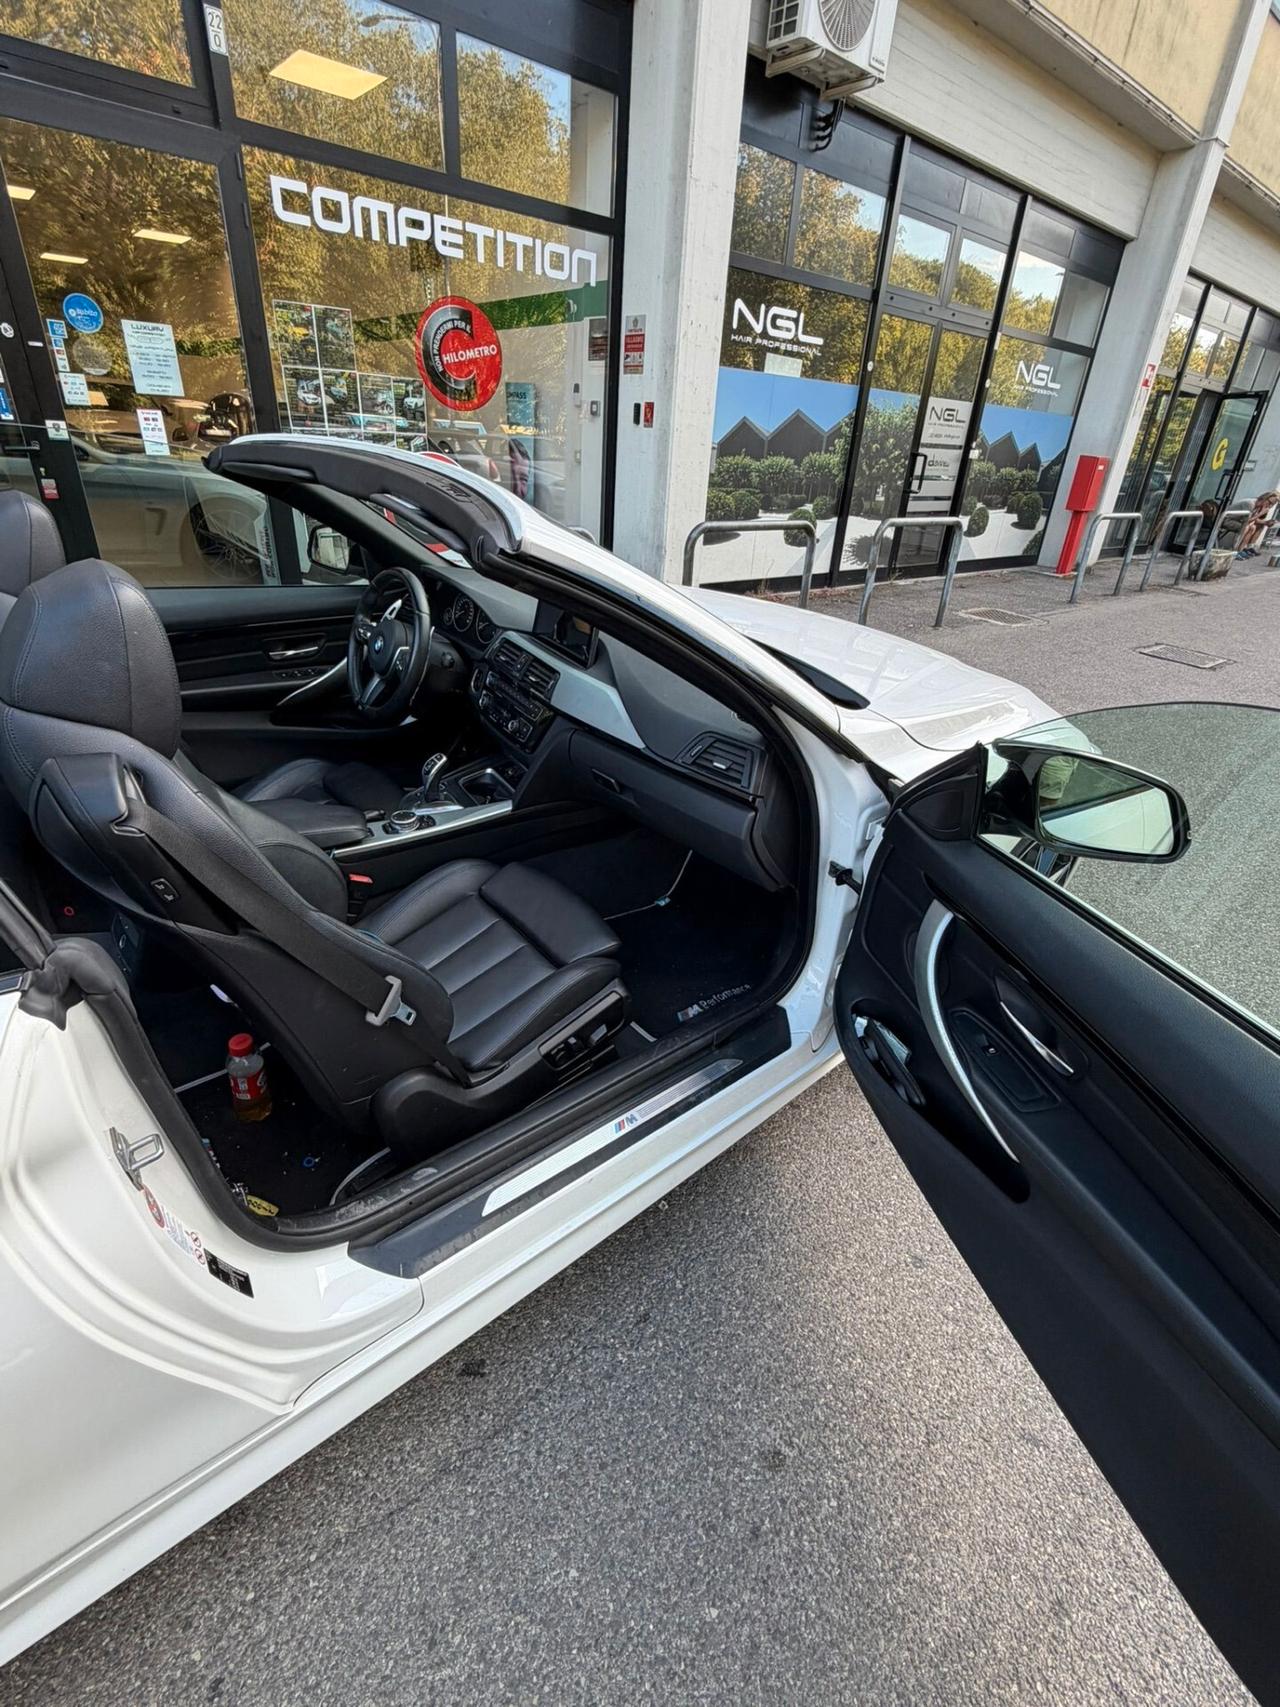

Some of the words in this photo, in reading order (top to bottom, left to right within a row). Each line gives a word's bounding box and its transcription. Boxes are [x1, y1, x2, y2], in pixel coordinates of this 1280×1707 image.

[208, 11, 222, 30] 22
[269, 174, 597, 287] COMPETITION
[732, 298, 824, 345] NGL
[731, 333, 753, 344] HAIR
[755, 336, 822, 357] PROFESSIONAL
[434, 355, 444, 372] NON
[1014, 359, 1062, 390] NGL
[929, 405, 966, 424] NGL
[1210, 437, 1229, 471] G
